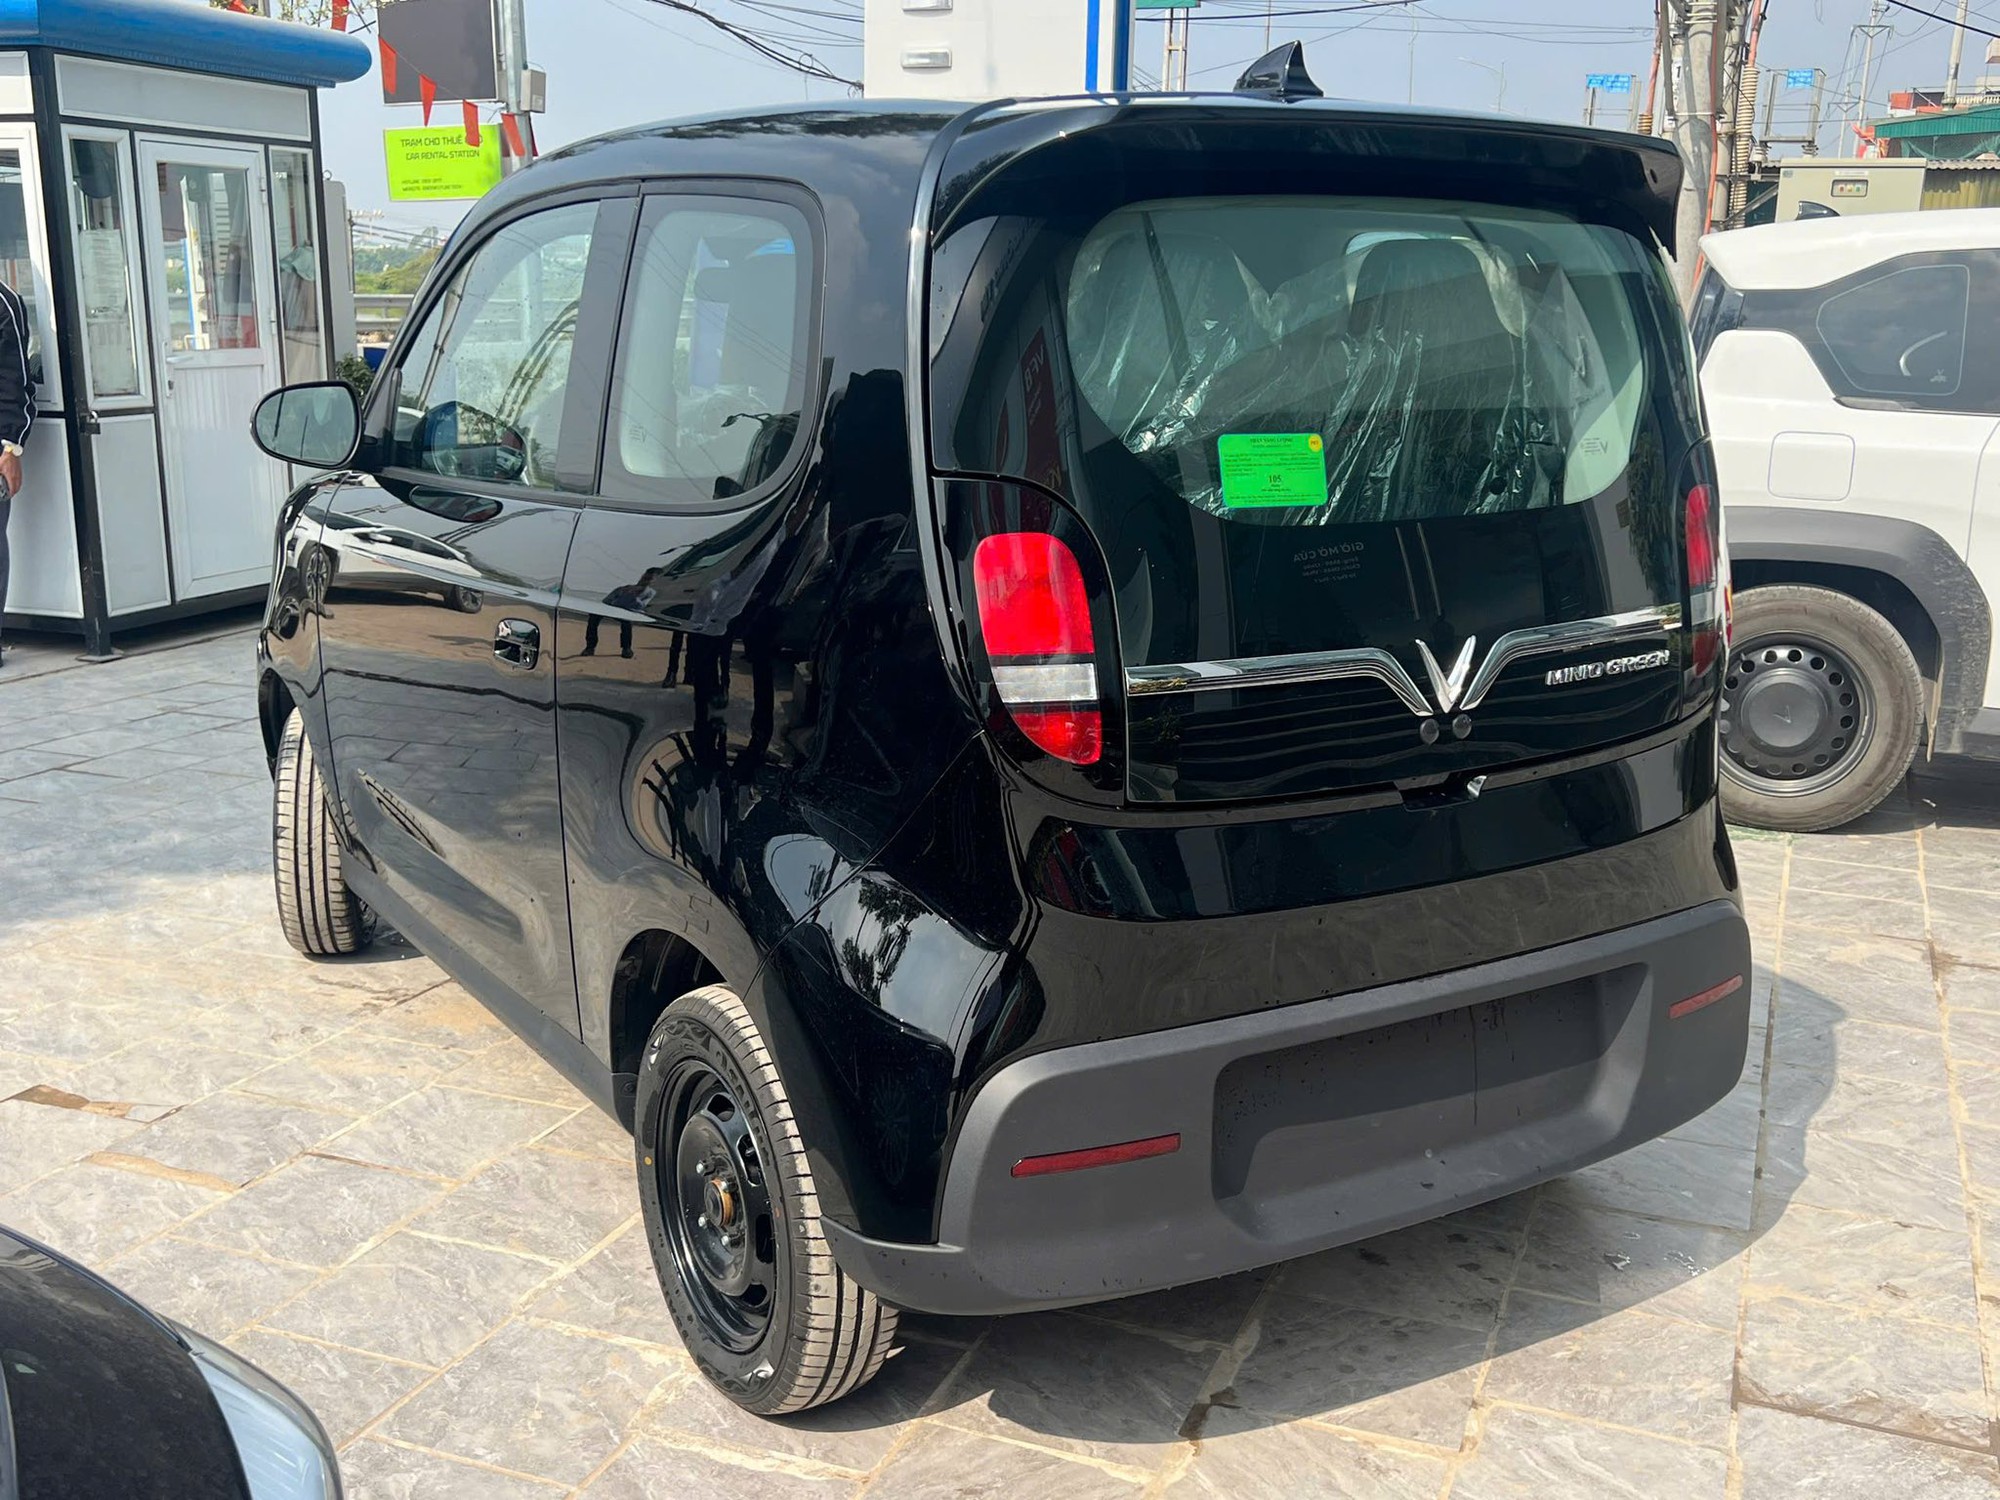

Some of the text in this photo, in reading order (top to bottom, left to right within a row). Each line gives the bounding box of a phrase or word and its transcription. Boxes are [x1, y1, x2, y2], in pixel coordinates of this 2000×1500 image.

[424, 137, 440, 147] CHO
[406, 149, 480, 161] CAR RENTAL STATION
[1269, 474, 1282, 483] 105
[1606, 649, 1670, 675] GREEN
